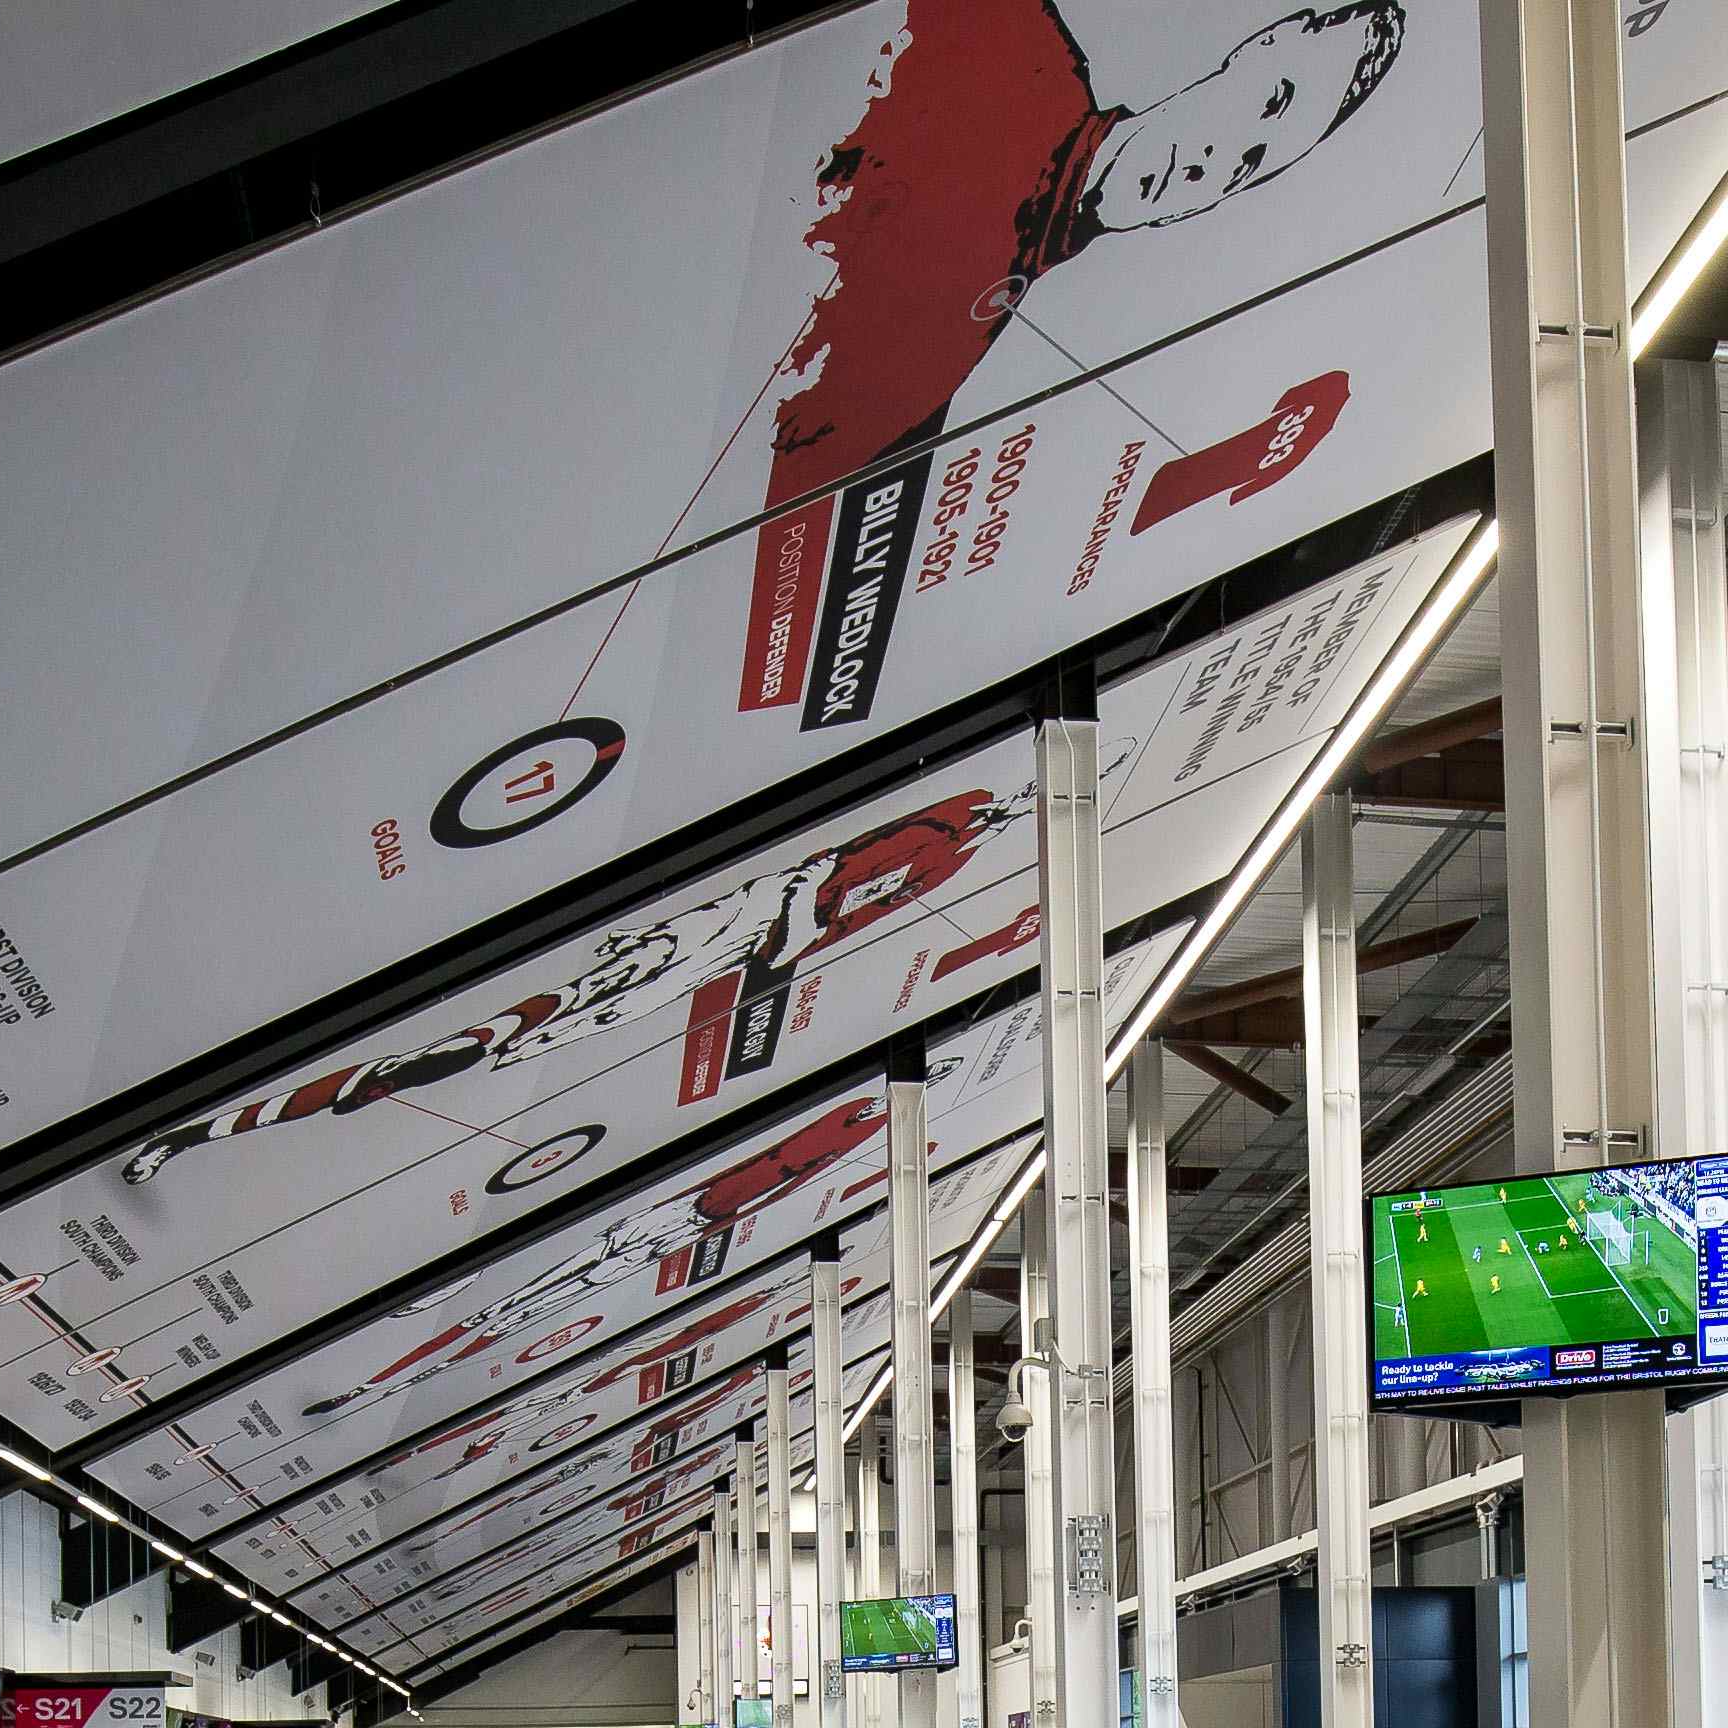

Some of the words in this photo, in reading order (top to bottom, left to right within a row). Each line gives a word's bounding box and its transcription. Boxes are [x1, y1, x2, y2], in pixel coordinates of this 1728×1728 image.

[1258, 405, 1314, 469] 393
[850, 479, 904, 578] BILLY
[914, 447, 982, 594] 1905-1921
[964, 424, 1036, 575] 1900-1901
[1066, 441, 1146, 597] APPEARANCES
[768, 522, 807, 617] POSITION
[758, 610, 791, 703] DEFENDER
[820, 572, 886, 723] WEDLOCK
[1230, 613, 1292, 689] TITLE
[1290, 589, 1343, 649] THE
[1304, 567, 1393, 684] MEMBER
[1180, 638, 1241, 714] TEAM
[1236, 646, 1302, 733] 1954/55
[1286, 677, 1321, 708] OF
[1174, 690, 1246, 782] WINNING
[504, 760, 555, 804] 17
[370, 817, 405, 881] GOALS
[0, 957, 55, 1019] DIVISION
[1382, 1364, 1411, 1376] Ready
[1413, 1364, 1423, 1373] to
[1424, 1361, 1454, 1372] tackle
[1382, 1376, 1399, 1386] our
[35, 1697, 81, 1720] S21
[109, 1696, 162, 1720] S22
